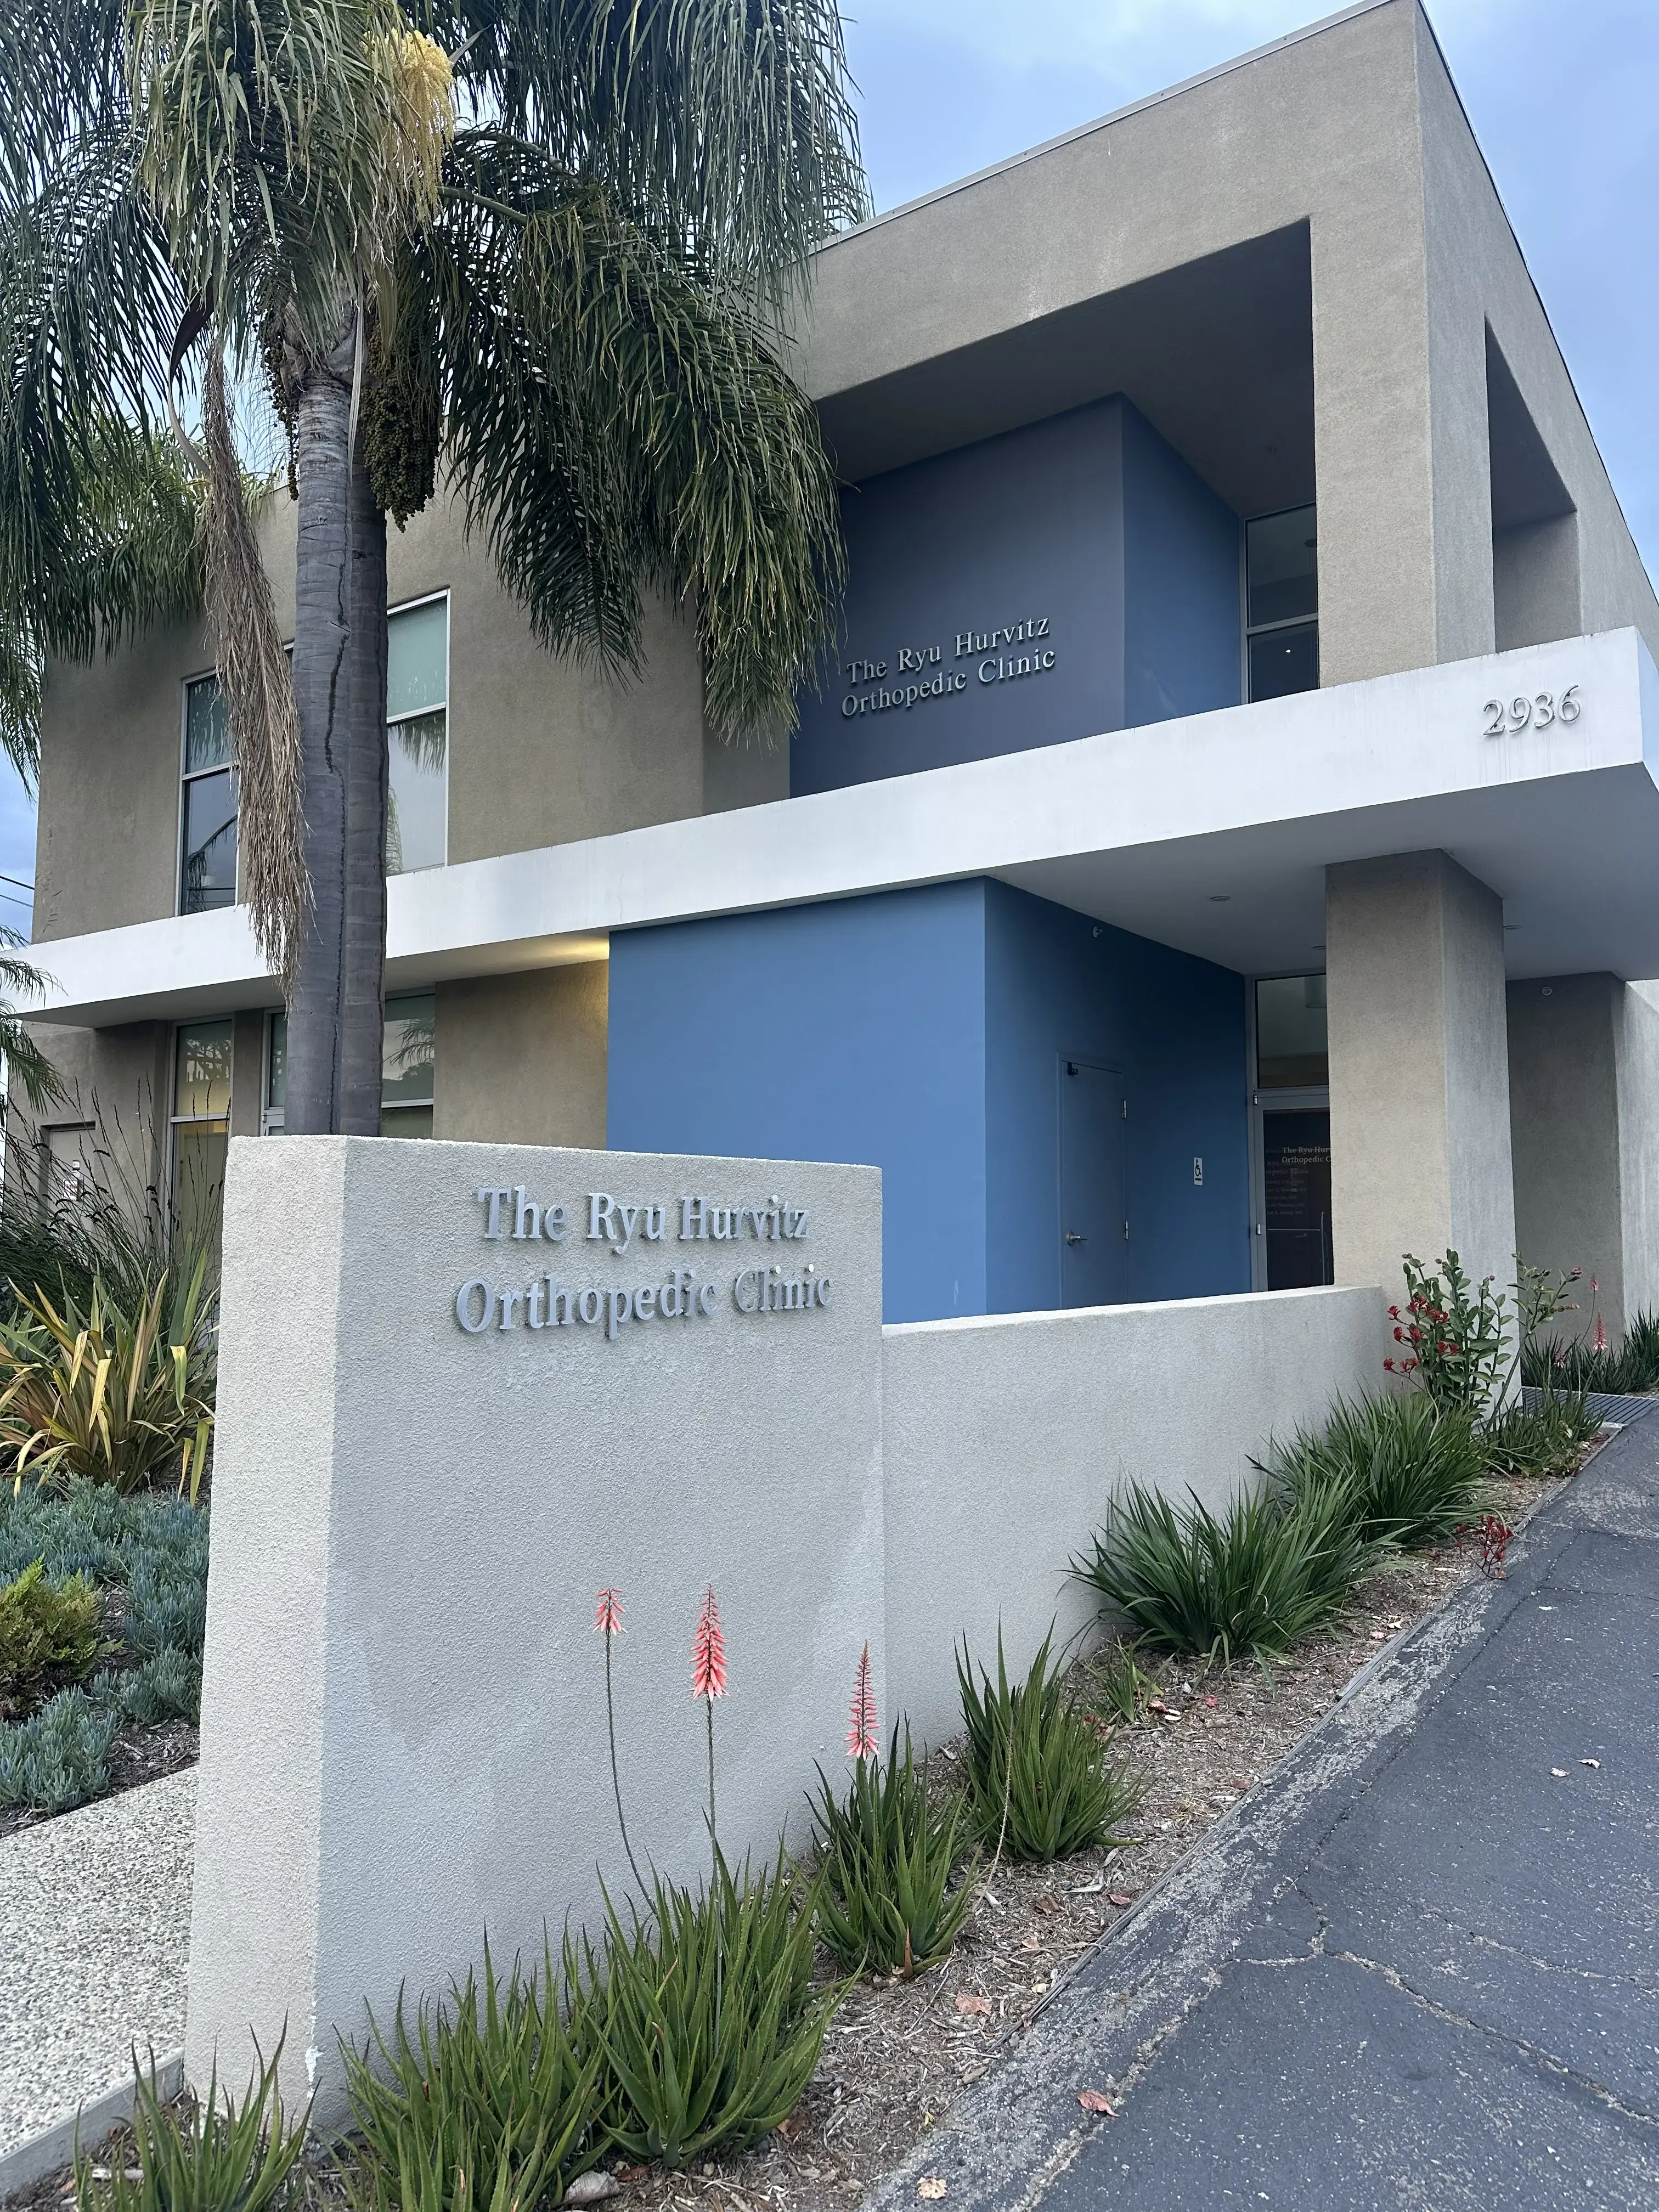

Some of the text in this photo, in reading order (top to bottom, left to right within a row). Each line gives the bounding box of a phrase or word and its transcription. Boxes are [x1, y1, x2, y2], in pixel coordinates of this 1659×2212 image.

[842, 648, 1055, 716] Orthopedic Clinic
[847, 618, 1049, 683] The Ryu Hurvitz
[1483, 684, 1581, 736] 2936
[1282, 1155, 1324, 1164] Orthopedic
[1297, 1146, 1312, 1155] Ryu
[478, 1185, 810, 1254] The Ryu Hurvitz
[456, 1263, 834, 1340] Orthopedic Clinic
